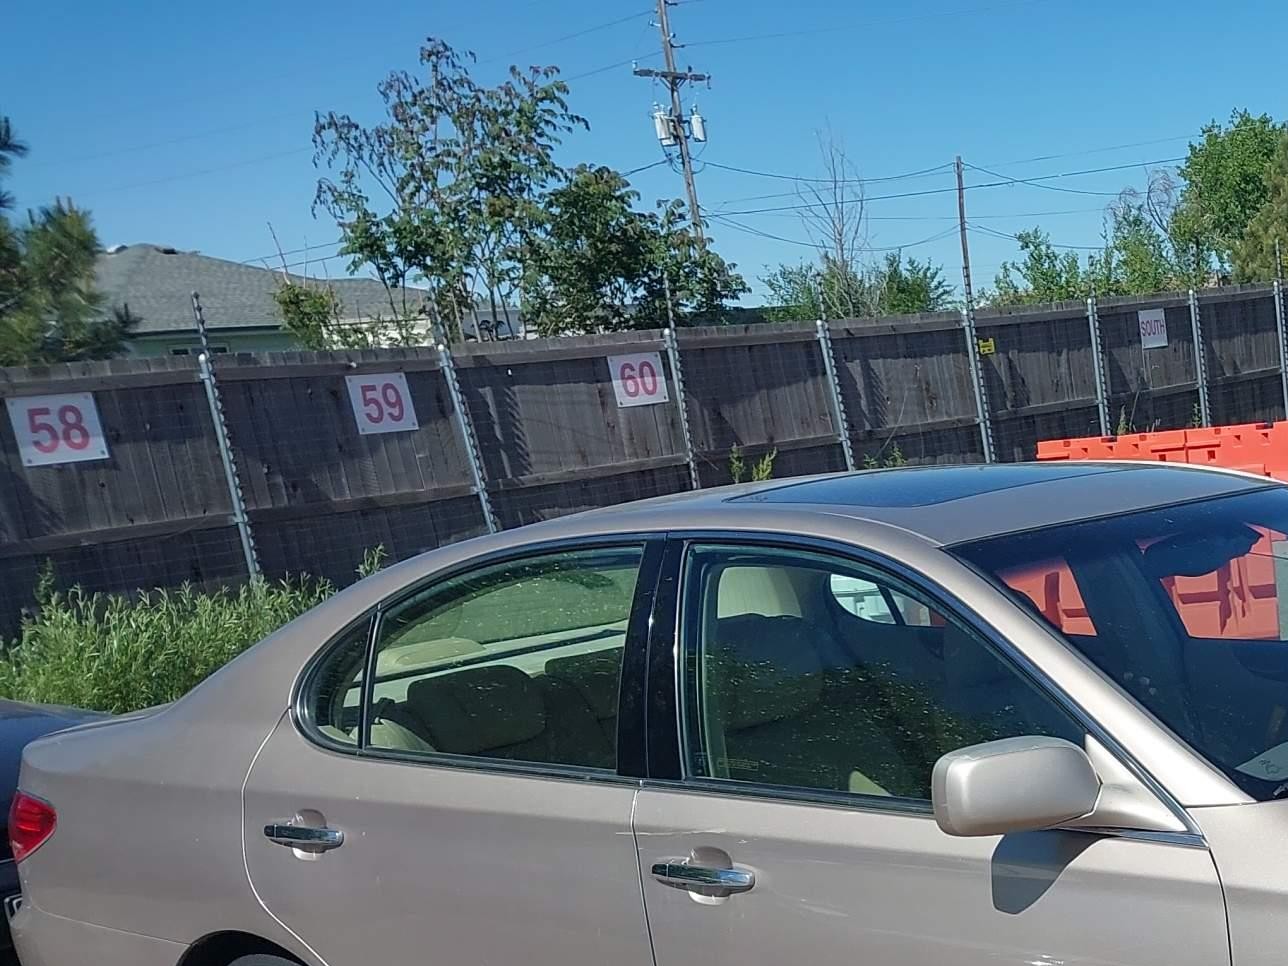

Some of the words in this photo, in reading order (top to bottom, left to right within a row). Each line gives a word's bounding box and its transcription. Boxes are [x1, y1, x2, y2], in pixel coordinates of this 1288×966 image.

[1141, 319, 1165, 336] SOUTH
[620, 360, 657, 397] 60
[360, 382, 404, 424] 59
[27, 404, 90, 453] 58
